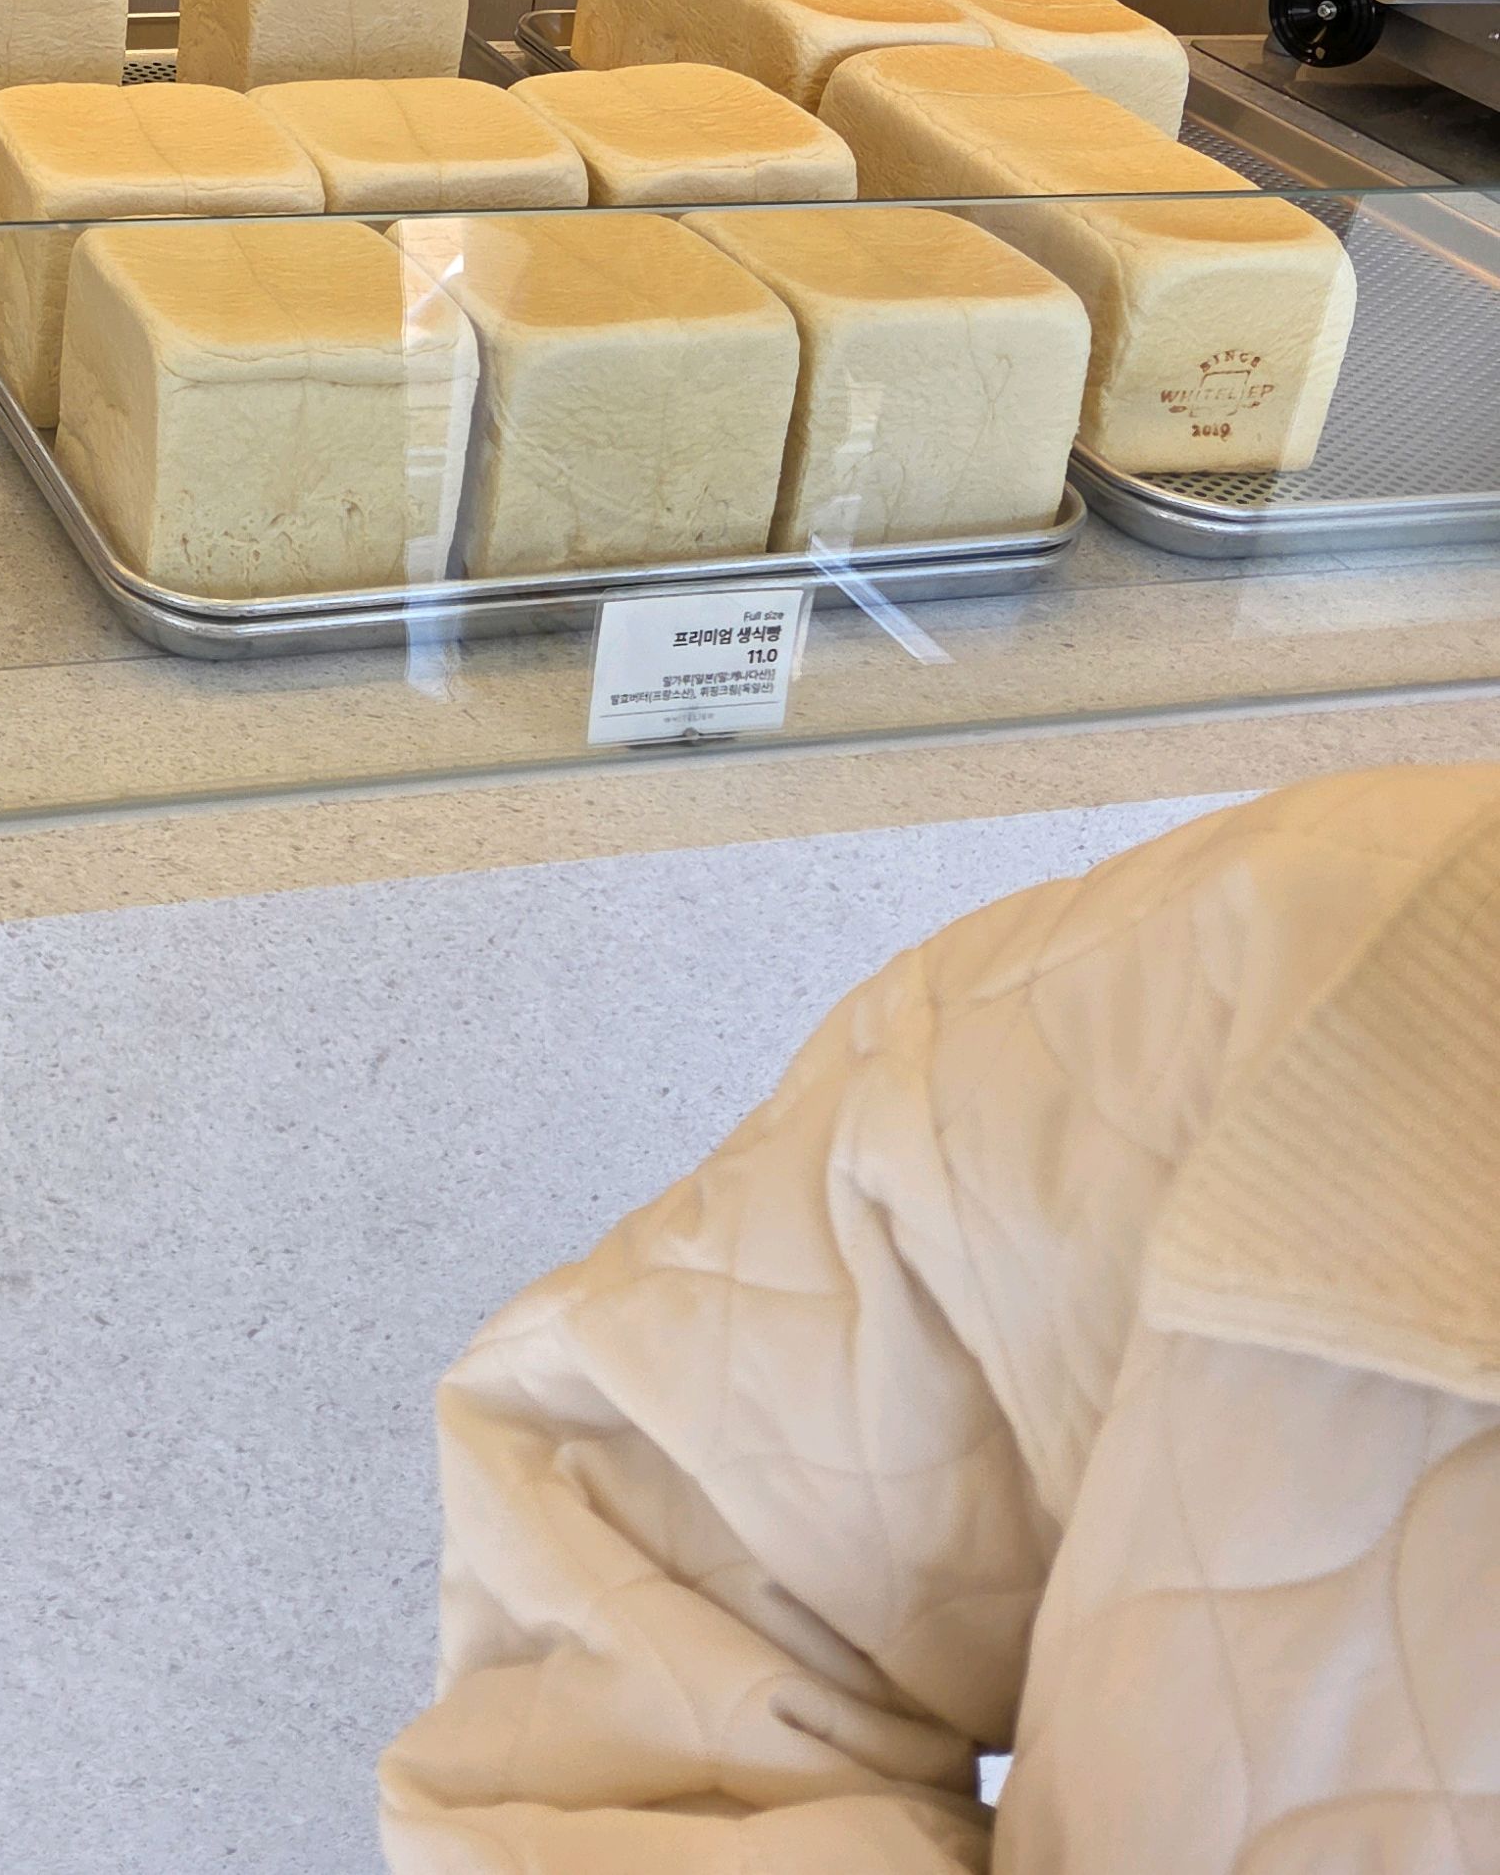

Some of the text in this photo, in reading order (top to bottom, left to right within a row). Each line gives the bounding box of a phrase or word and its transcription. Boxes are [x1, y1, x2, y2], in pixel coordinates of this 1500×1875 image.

[673, 625, 781, 647] 프리미엄 생식빵
[747, 648, 778, 664] 11.0
